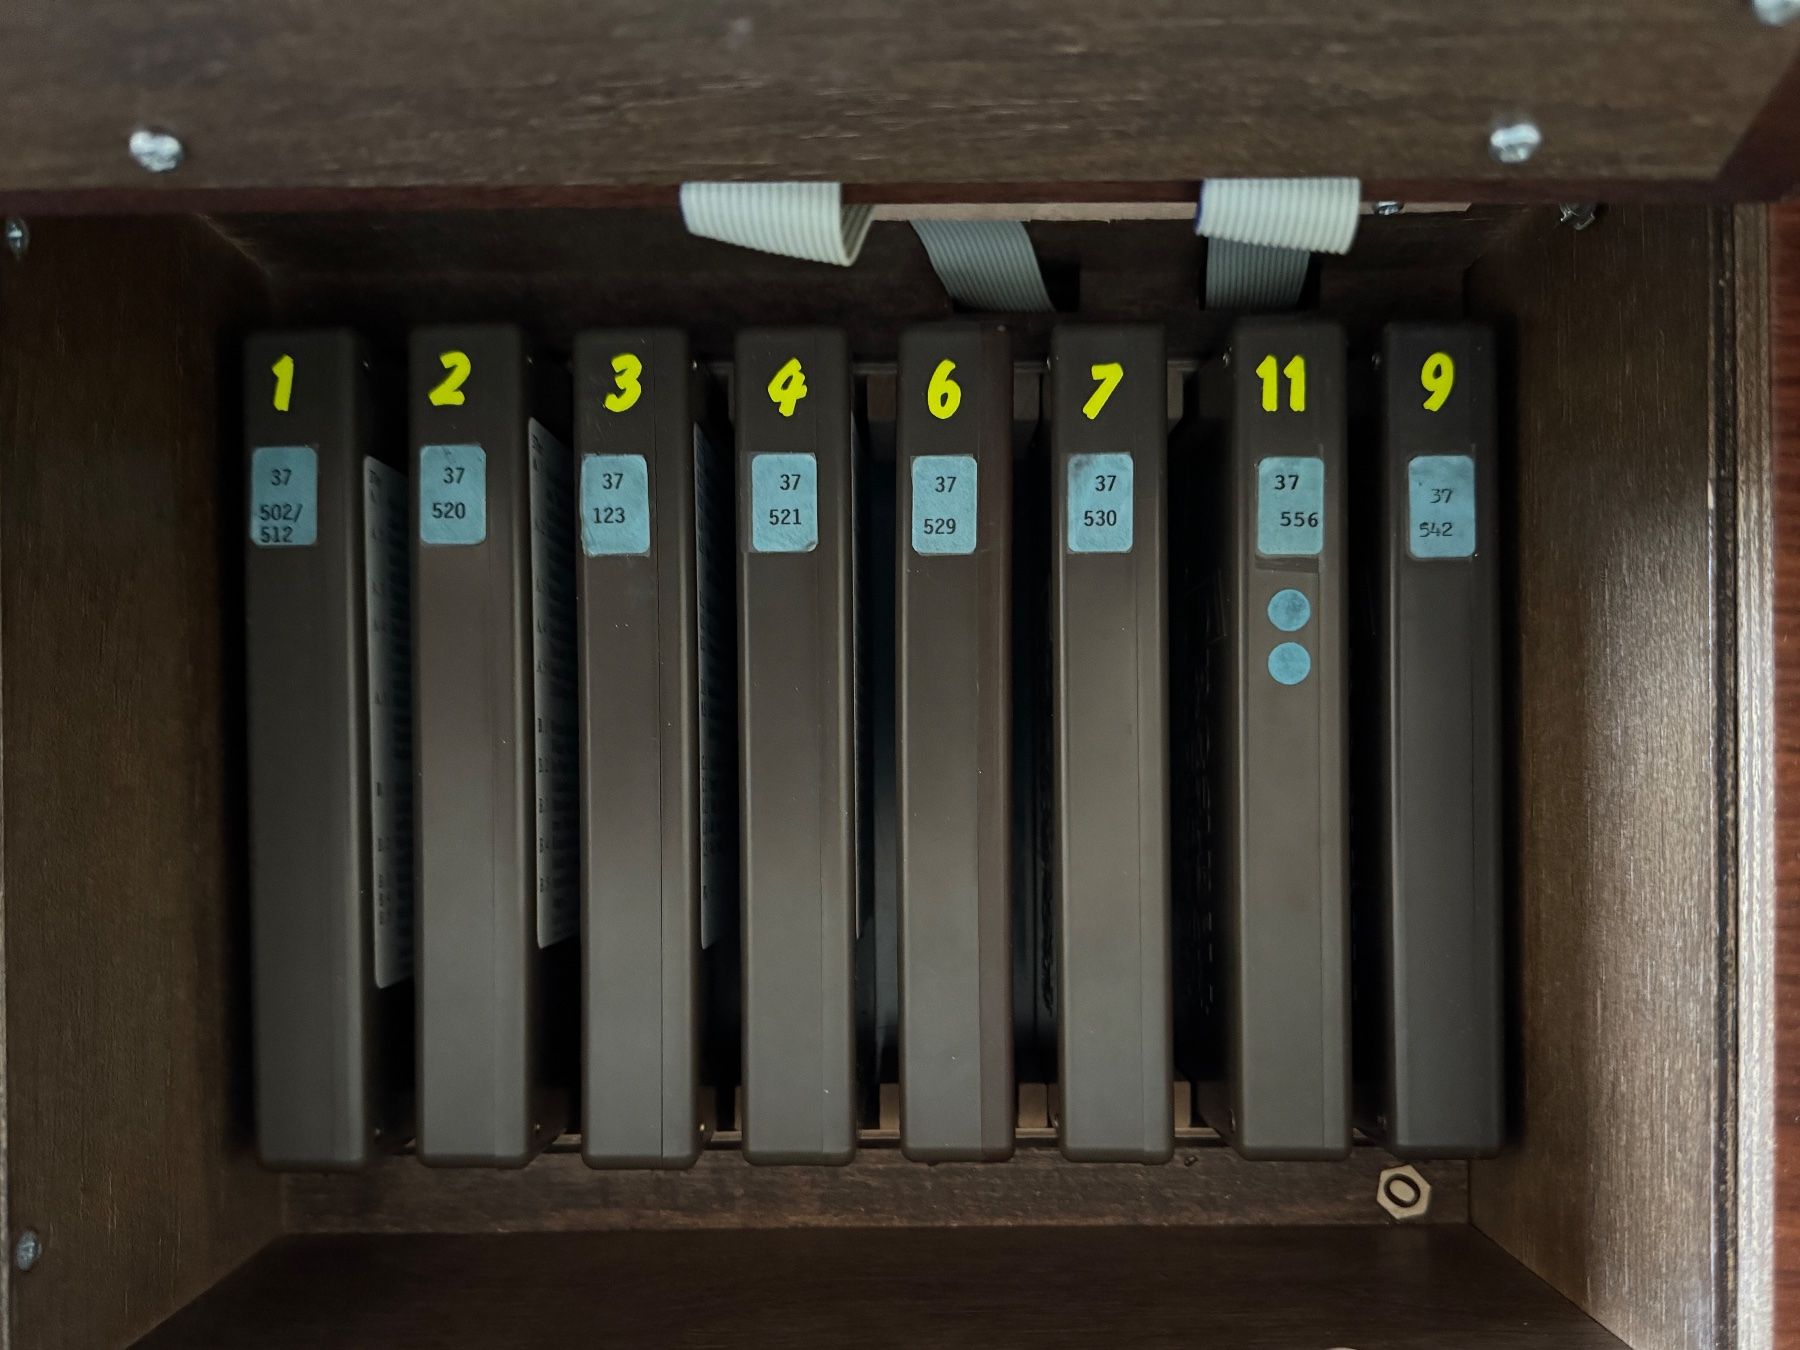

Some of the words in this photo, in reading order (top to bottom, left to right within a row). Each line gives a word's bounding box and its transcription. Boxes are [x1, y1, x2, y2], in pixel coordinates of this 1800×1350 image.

[271, 355, 294, 412] 1
[428, 351, 472, 407] 2
[603, 353, 643, 413] 3
[767, 357, 808, 418] 4
[1255, 354, 1306, 413] 11
[1420, 352, 1455, 412] 9
[927, 358, 962, 420] 6
[1082, 362, 1124, 420] 7
[271, 468, 292, 486] 37
[443, 466, 465, 485] 37
[602, 472, 624, 490] 37
[779, 473, 801, 491] 37
[934, 475, 957, 493] 37
[1095, 474, 1117, 492] 37
[1274, 474, 1300, 491] 37
[1430, 488, 1454, 504] 37
[260, 503, 303, 523] 502/
[432, 501, 466, 520] 520
[593, 506, 626, 524] 123
[769, 508, 802, 526] 521
[1083, 509, 1117, 527] 530
[1279, 511, 1319, 528] 556
[261, 526, 293, 543] 512
[923, 517, 957, 535] 529
[1419, 521, 1453, 538] 542
